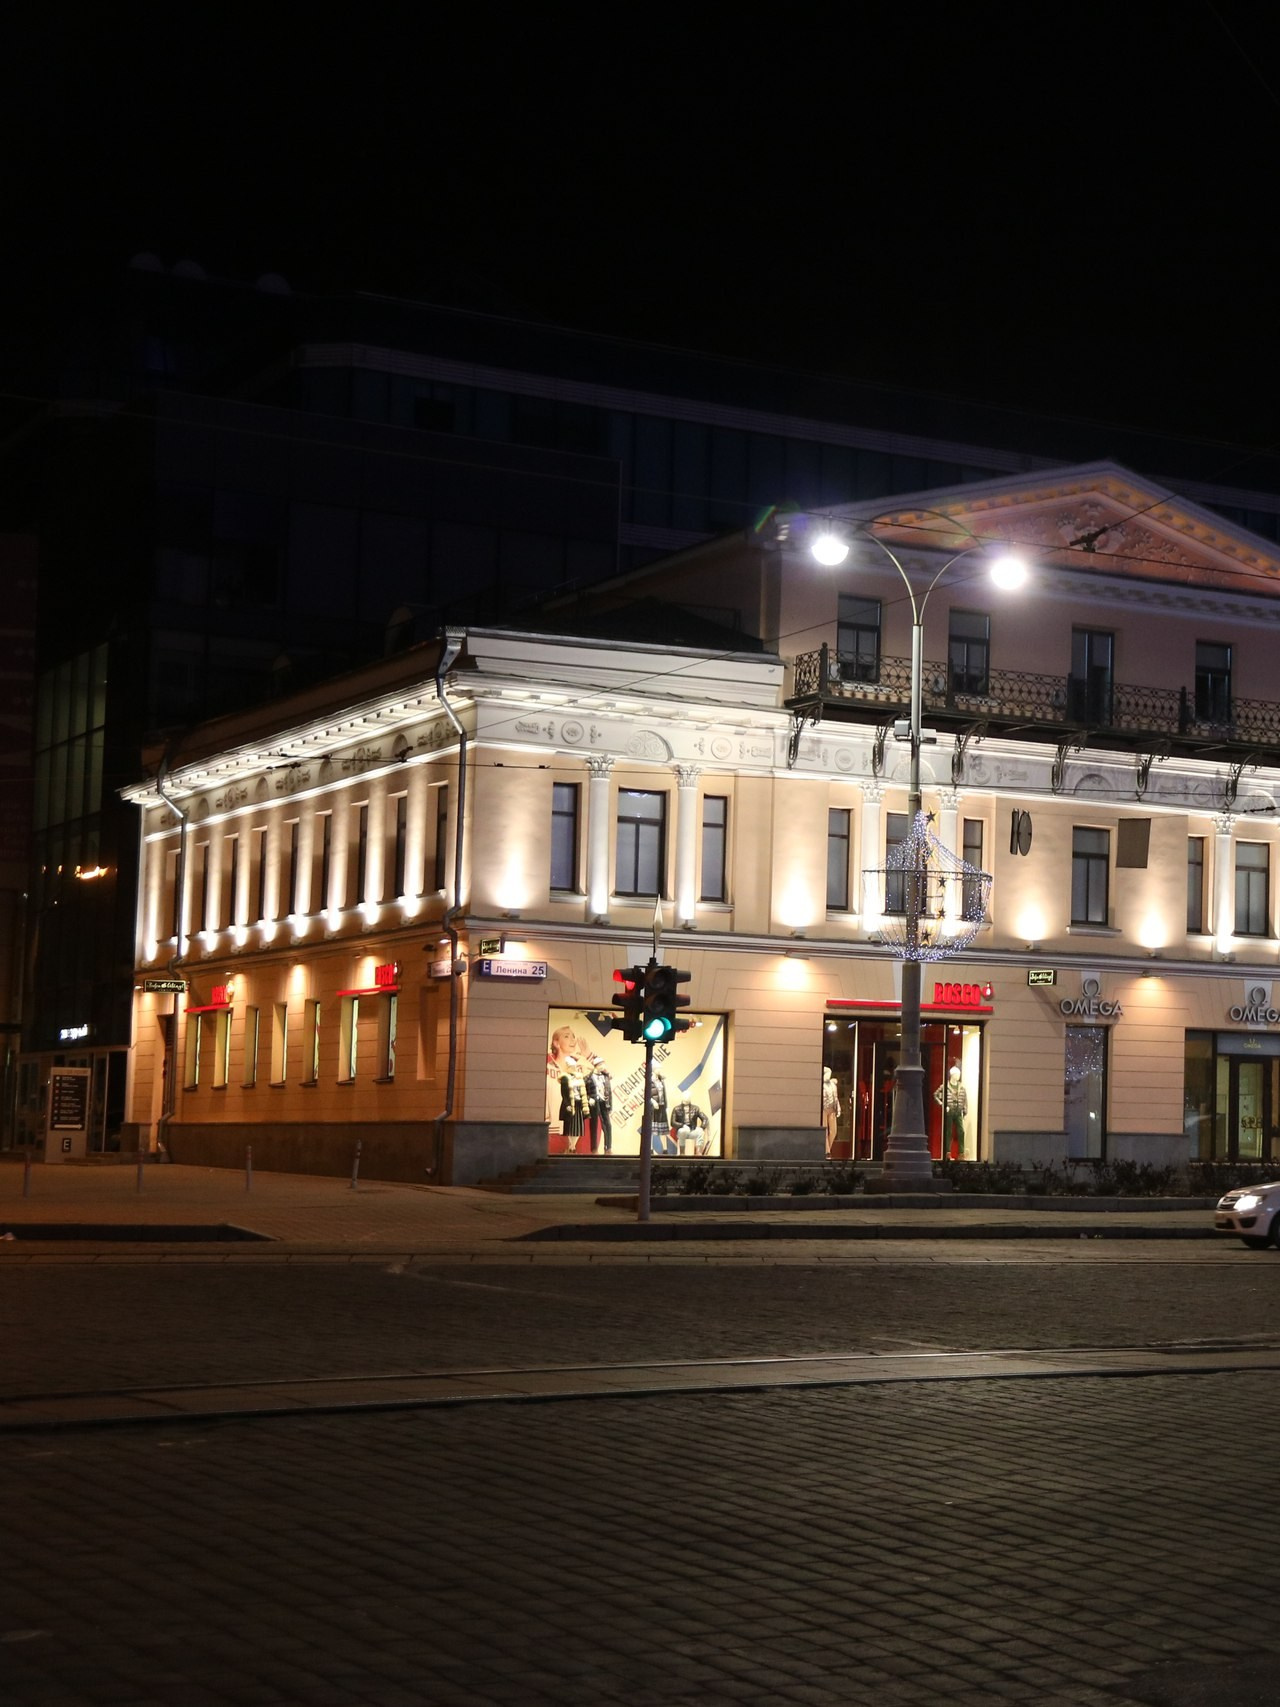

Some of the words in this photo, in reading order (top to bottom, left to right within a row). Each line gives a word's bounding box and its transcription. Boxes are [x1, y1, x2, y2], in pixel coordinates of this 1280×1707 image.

[496, 966, 527, 974] Ленина
[532, 966, 544, 975] 25
[933, 982, 981, 1006] BOSCO
[1060, 998, 1123, 1016] OMEGA
